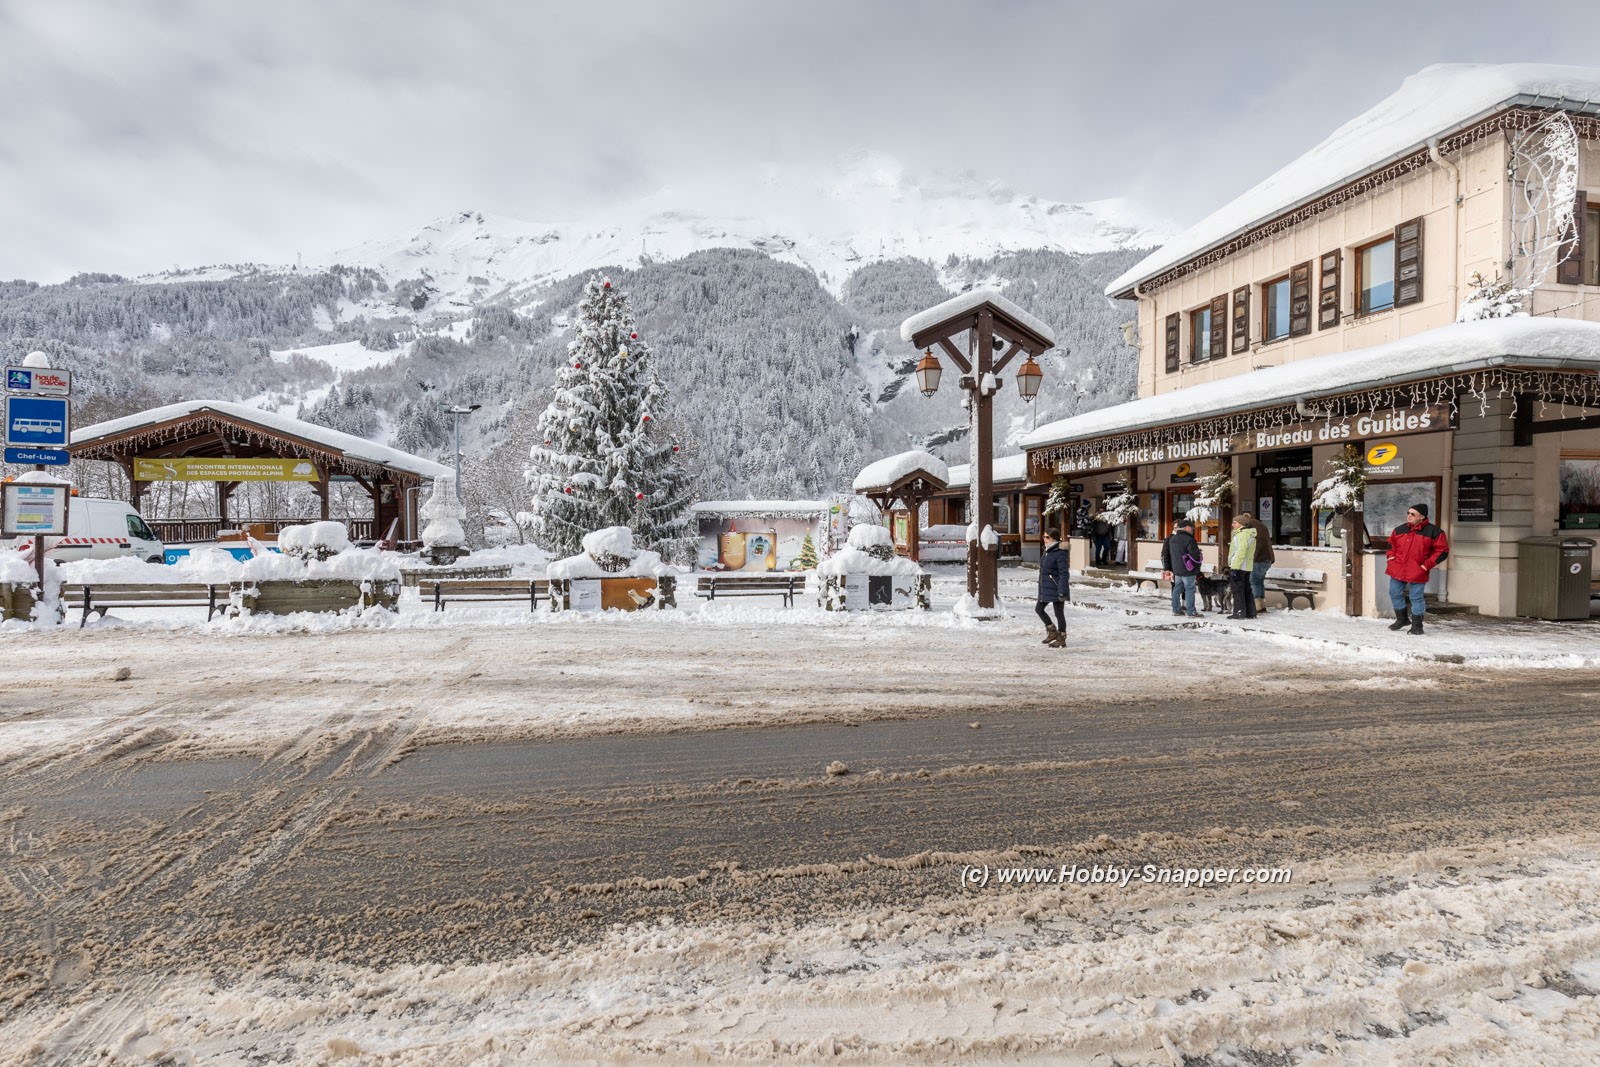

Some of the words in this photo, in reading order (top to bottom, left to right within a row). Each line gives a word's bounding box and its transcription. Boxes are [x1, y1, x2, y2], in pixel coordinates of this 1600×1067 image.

[1256, 429, 1313, 448] Bureau
[1319, 422, 1350, 441] des
[1357, 411, 1431, 436] Guides
[16, 452, 57, 461] Chef-Lieu
[1118, 449, 1149, 464] OFFICE
[1151, 448, 1164, 461] de
[1167, 438, 1229, 459] TOURISME
[1078, 459, 1087, 470] de
[1089, 456, 1101, 469] Ski
